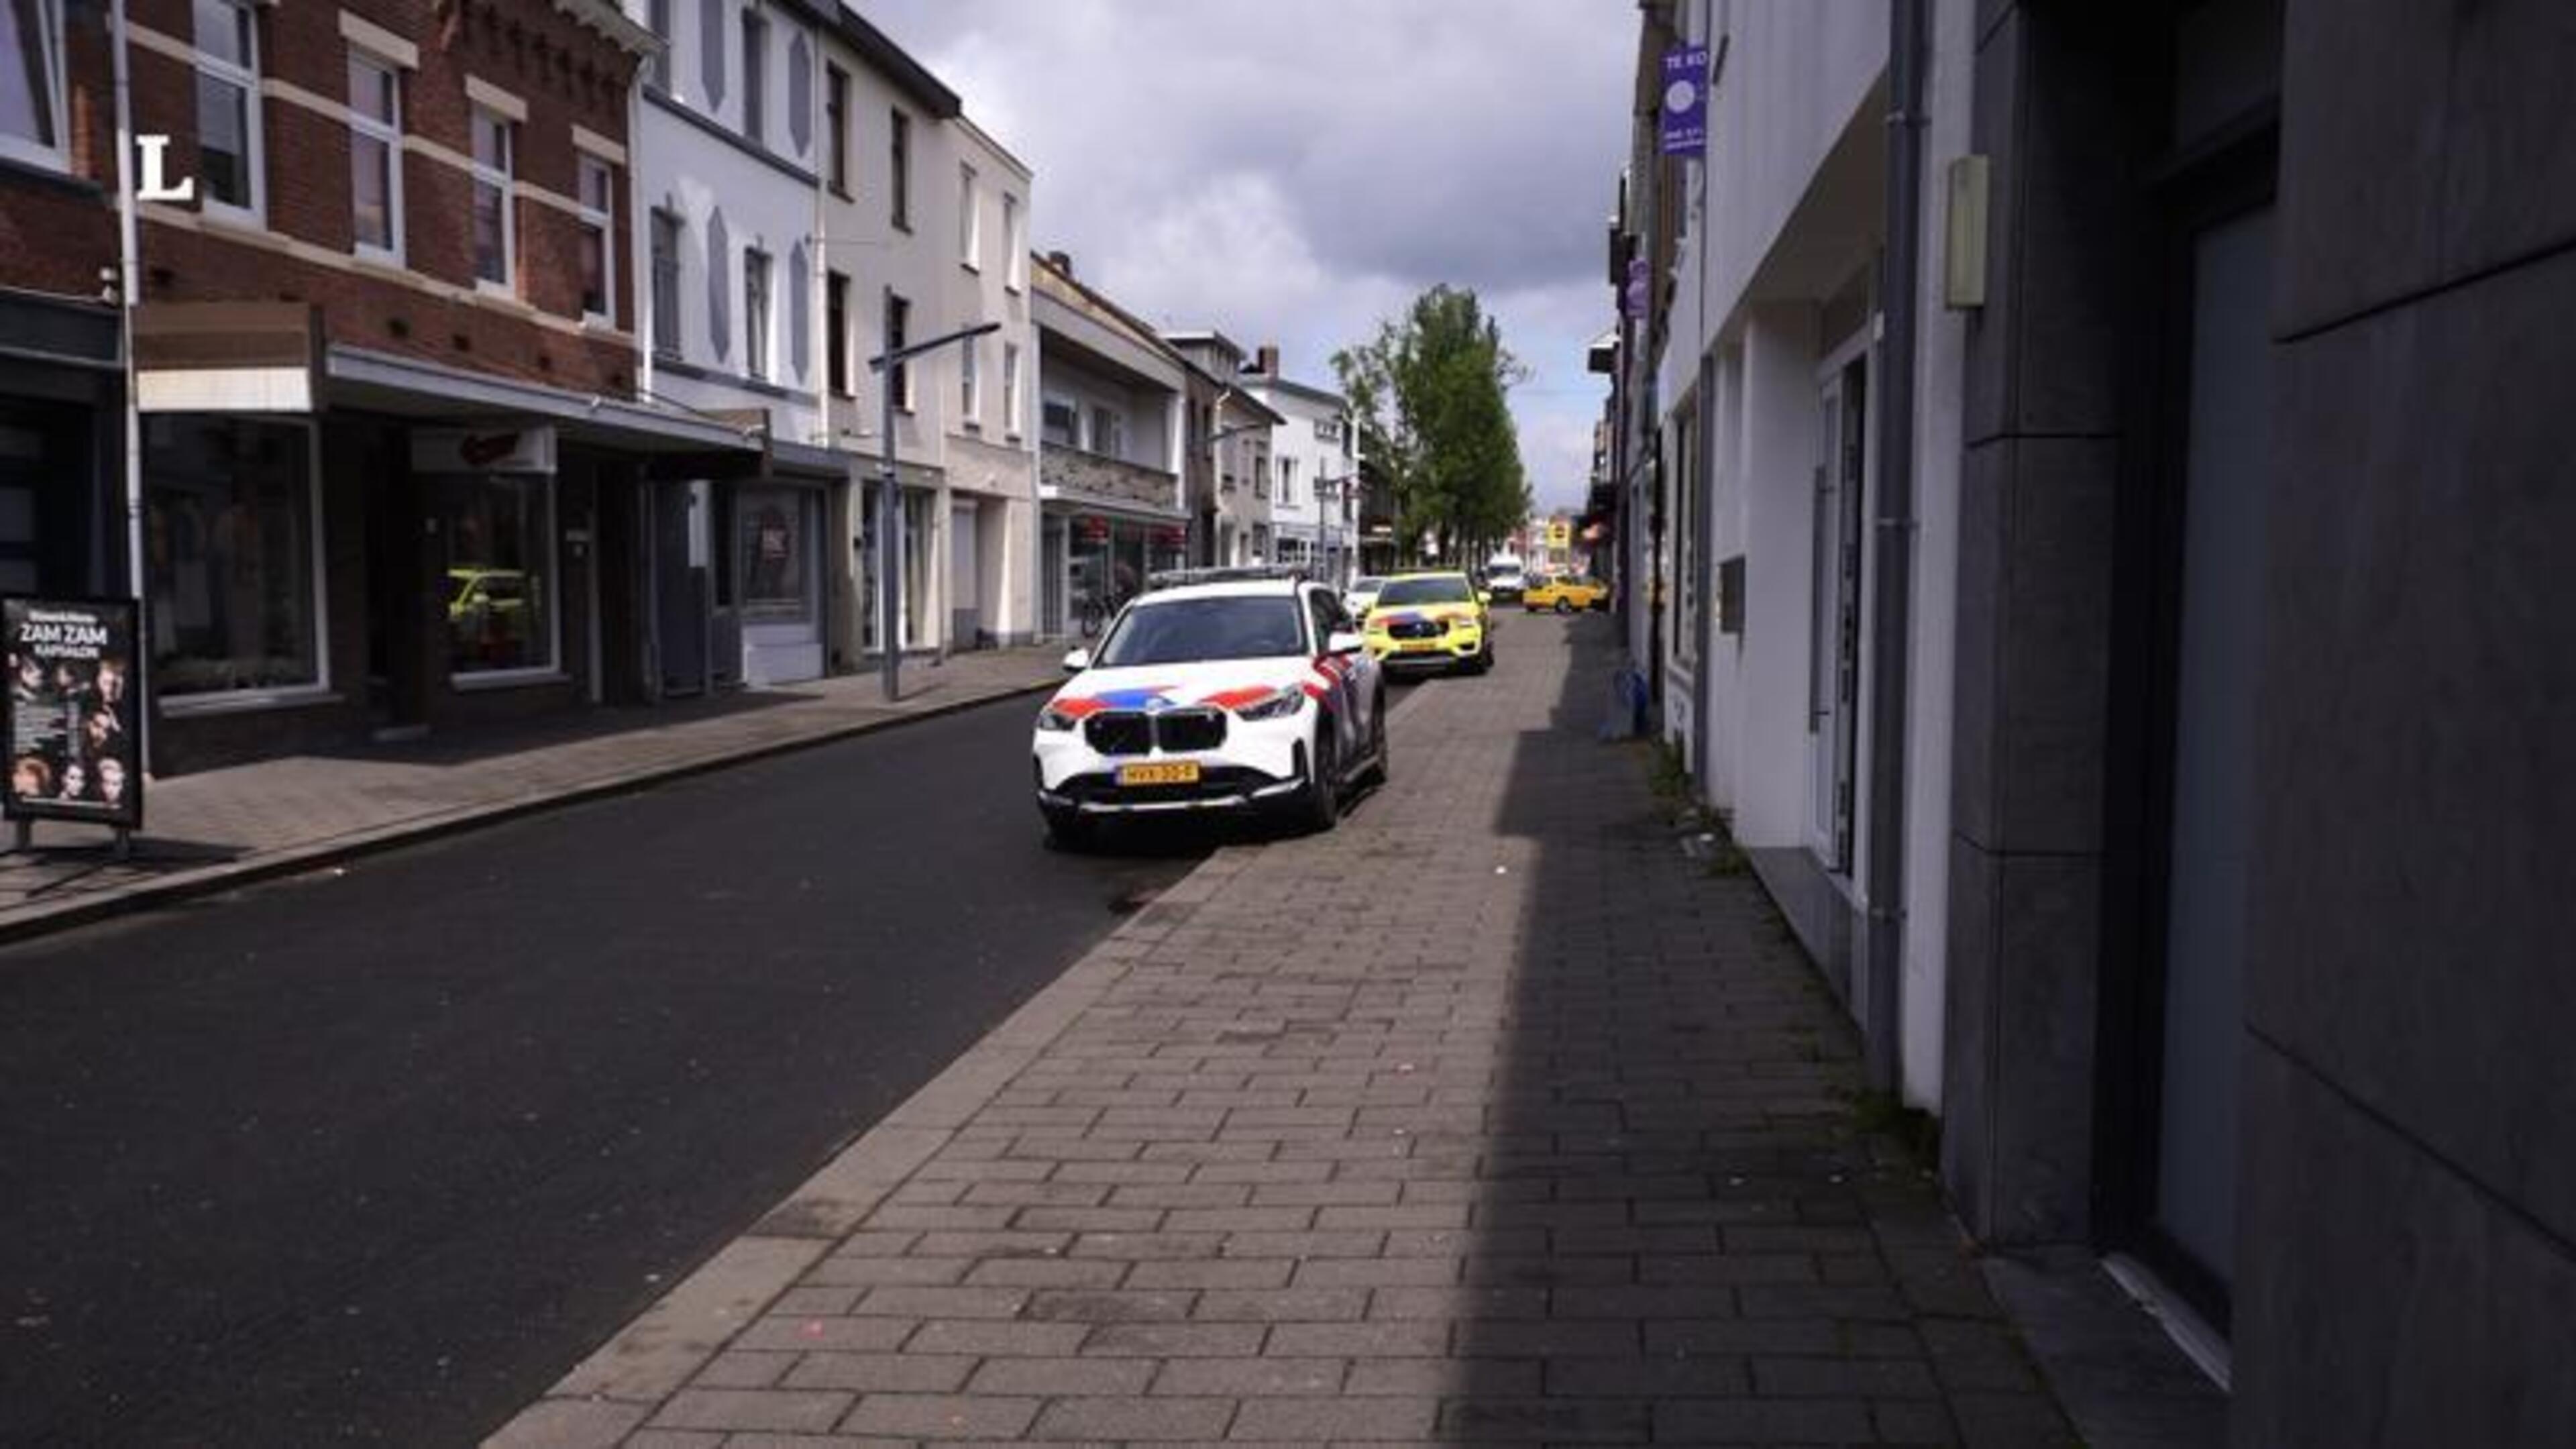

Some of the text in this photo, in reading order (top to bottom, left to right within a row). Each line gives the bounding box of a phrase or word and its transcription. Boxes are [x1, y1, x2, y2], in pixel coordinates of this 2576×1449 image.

[1666, 56, 1682, 69] TE
[20, 622, 107, 645] ZAM ZAM
[34, 644, 99, 658] KAPSALON
